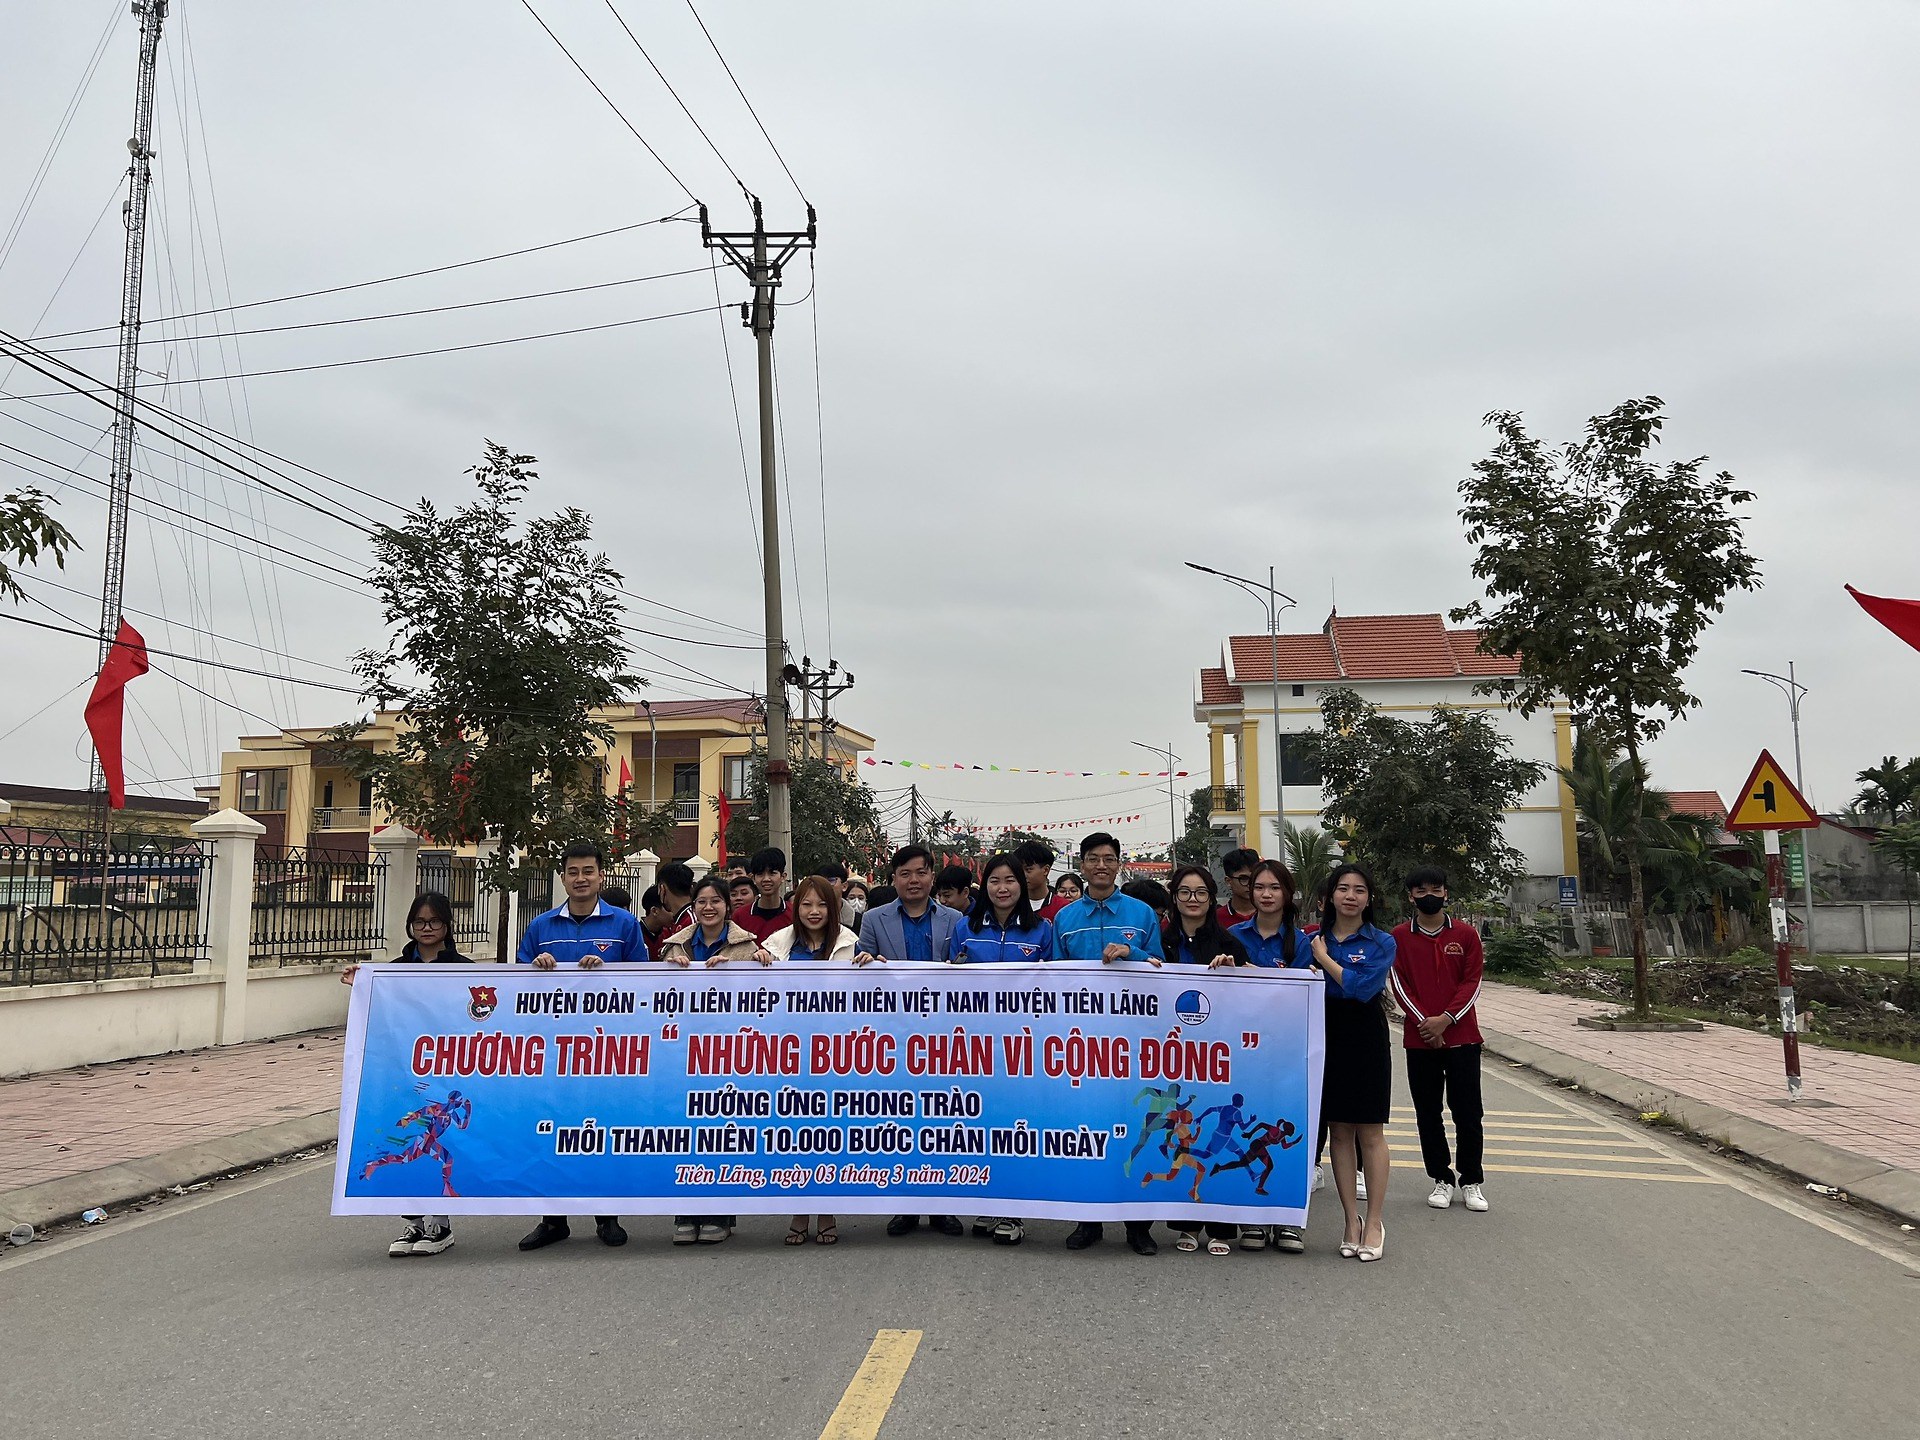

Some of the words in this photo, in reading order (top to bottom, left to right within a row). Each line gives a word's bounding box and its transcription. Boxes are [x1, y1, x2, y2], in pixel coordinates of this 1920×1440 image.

[516, 988, 577, 1018] HUYỆN
[582, 988, 635, 1013] ĐOÀN
[653, 987, 684, 1018] HỘI
[690, 987, 731, 1013] LIÊN
[738, 987, 780, 1018] HIỆP
[786, 991, 847, 1013] THANH
[852, 987, 897, 1013] NIÊN
[902, 987, 941, 1018] VIỆT
[946, 991, 989, 1013] NAM
[995, 987, 1056, 1018] HUYỆN
[1062, 988, 1104, 1014] TIÊN
[1110, 989, 1159, 1017] LÃNG
[412, 1032, 545, 1076] CHƯƠNG
[555, 1027, 650, 1076] TRÌNH
[687, 1027, 800, 1075] NHỮNG
[810, 1026, 896, 1075] BƯỚC
[906, 1026, 993, 1076] CHÂN
[1003, 1027, 1033, 1076] VÌ
[1043, 1027, 1130, 1087] CỘNG
[1139, 1026, 1230, 1083] ĐỒNG
[688, 1084, 770, 1117] HƯỞNG
[777, 1087, 826, 1116] ỨNG
[833, 1091, 914, 1117] PHONG
[920, 1088, 981, 1117] TRÀO
[611, 1128, 690, 1153] THANH
[697, 1124, 755, 1153] NIÊN
[763, 1128, 842, 1153] 10.000
[848, 1123, 912, 1153] BƯỚC
[920, 1124, 984, 1154] CHÂN
[992, 1121, 1037, 1155] MỖI
[676, 1166, 714, 1183] Tiên
[719, 1166, 766, 1187] Lãng,
[772, 1167, 811, 1187] ngày
[815, 1165, 836, 1183] 03
[840, 1165, 889, 1187] tháng
[892, 1165, 903, 1183] 3
[908, 1166, 946, 1183] năm
[949, 1166, 990, 1183] 2024
